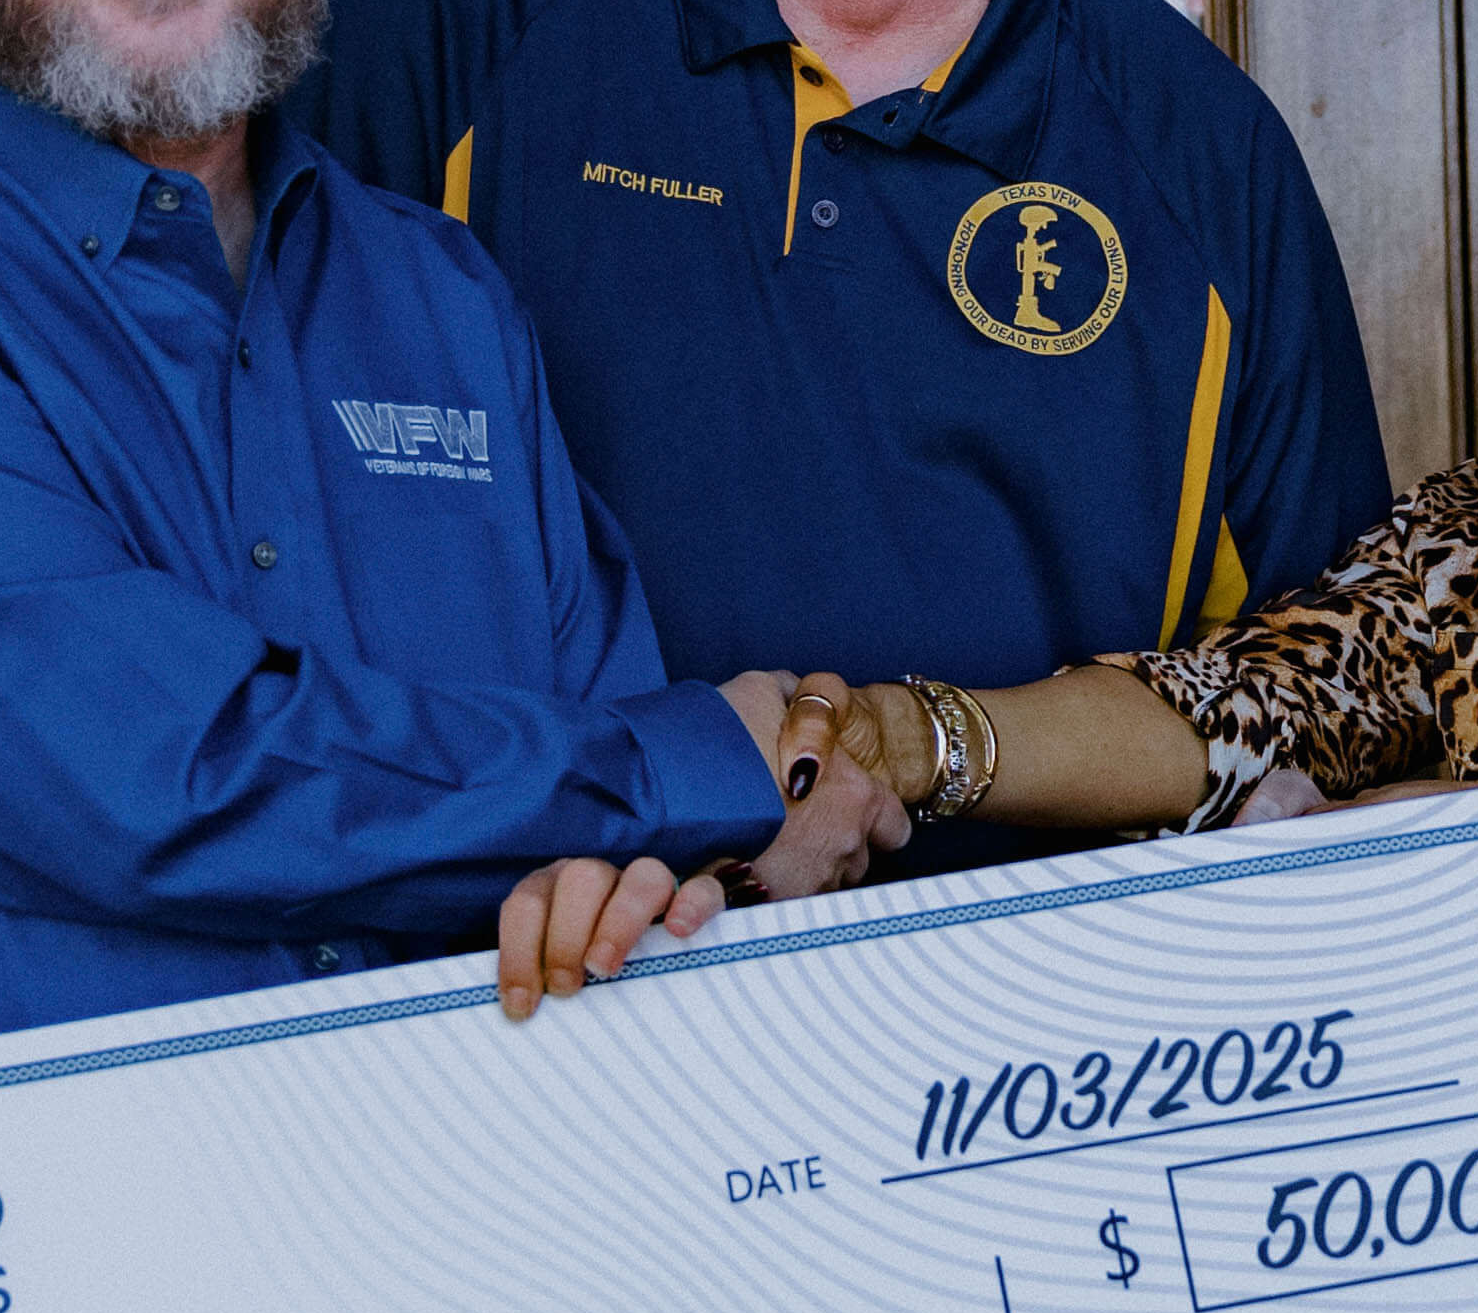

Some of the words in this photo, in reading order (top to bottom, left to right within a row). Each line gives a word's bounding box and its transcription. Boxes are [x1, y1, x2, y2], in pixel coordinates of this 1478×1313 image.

[583, 161, 646, 192] MITCH
[650, 177, 724, 206] FULLER
[998, 185, 1047, 202] TEXAS
[1051, 187, 1082, 208] VFW
[951, 220, 976, 298] HONORING
[1104, 237, 1123, 284] LIVING
[963, 298, 989, 327] OUR
[1100, 288, 1122, 319] OUR
[987, 323, 1027, 346] DEAD
[1031, 337, 1048, 351] BY
[1053, 318, 1103, 351] SERVING
[333, 400, 490, 462] VFW
[724, 1153, 827, 1205] DATE
[913, 1008, 1356, 1163] 11/03/2025
[1097, 1207, 1143, 1292] $
